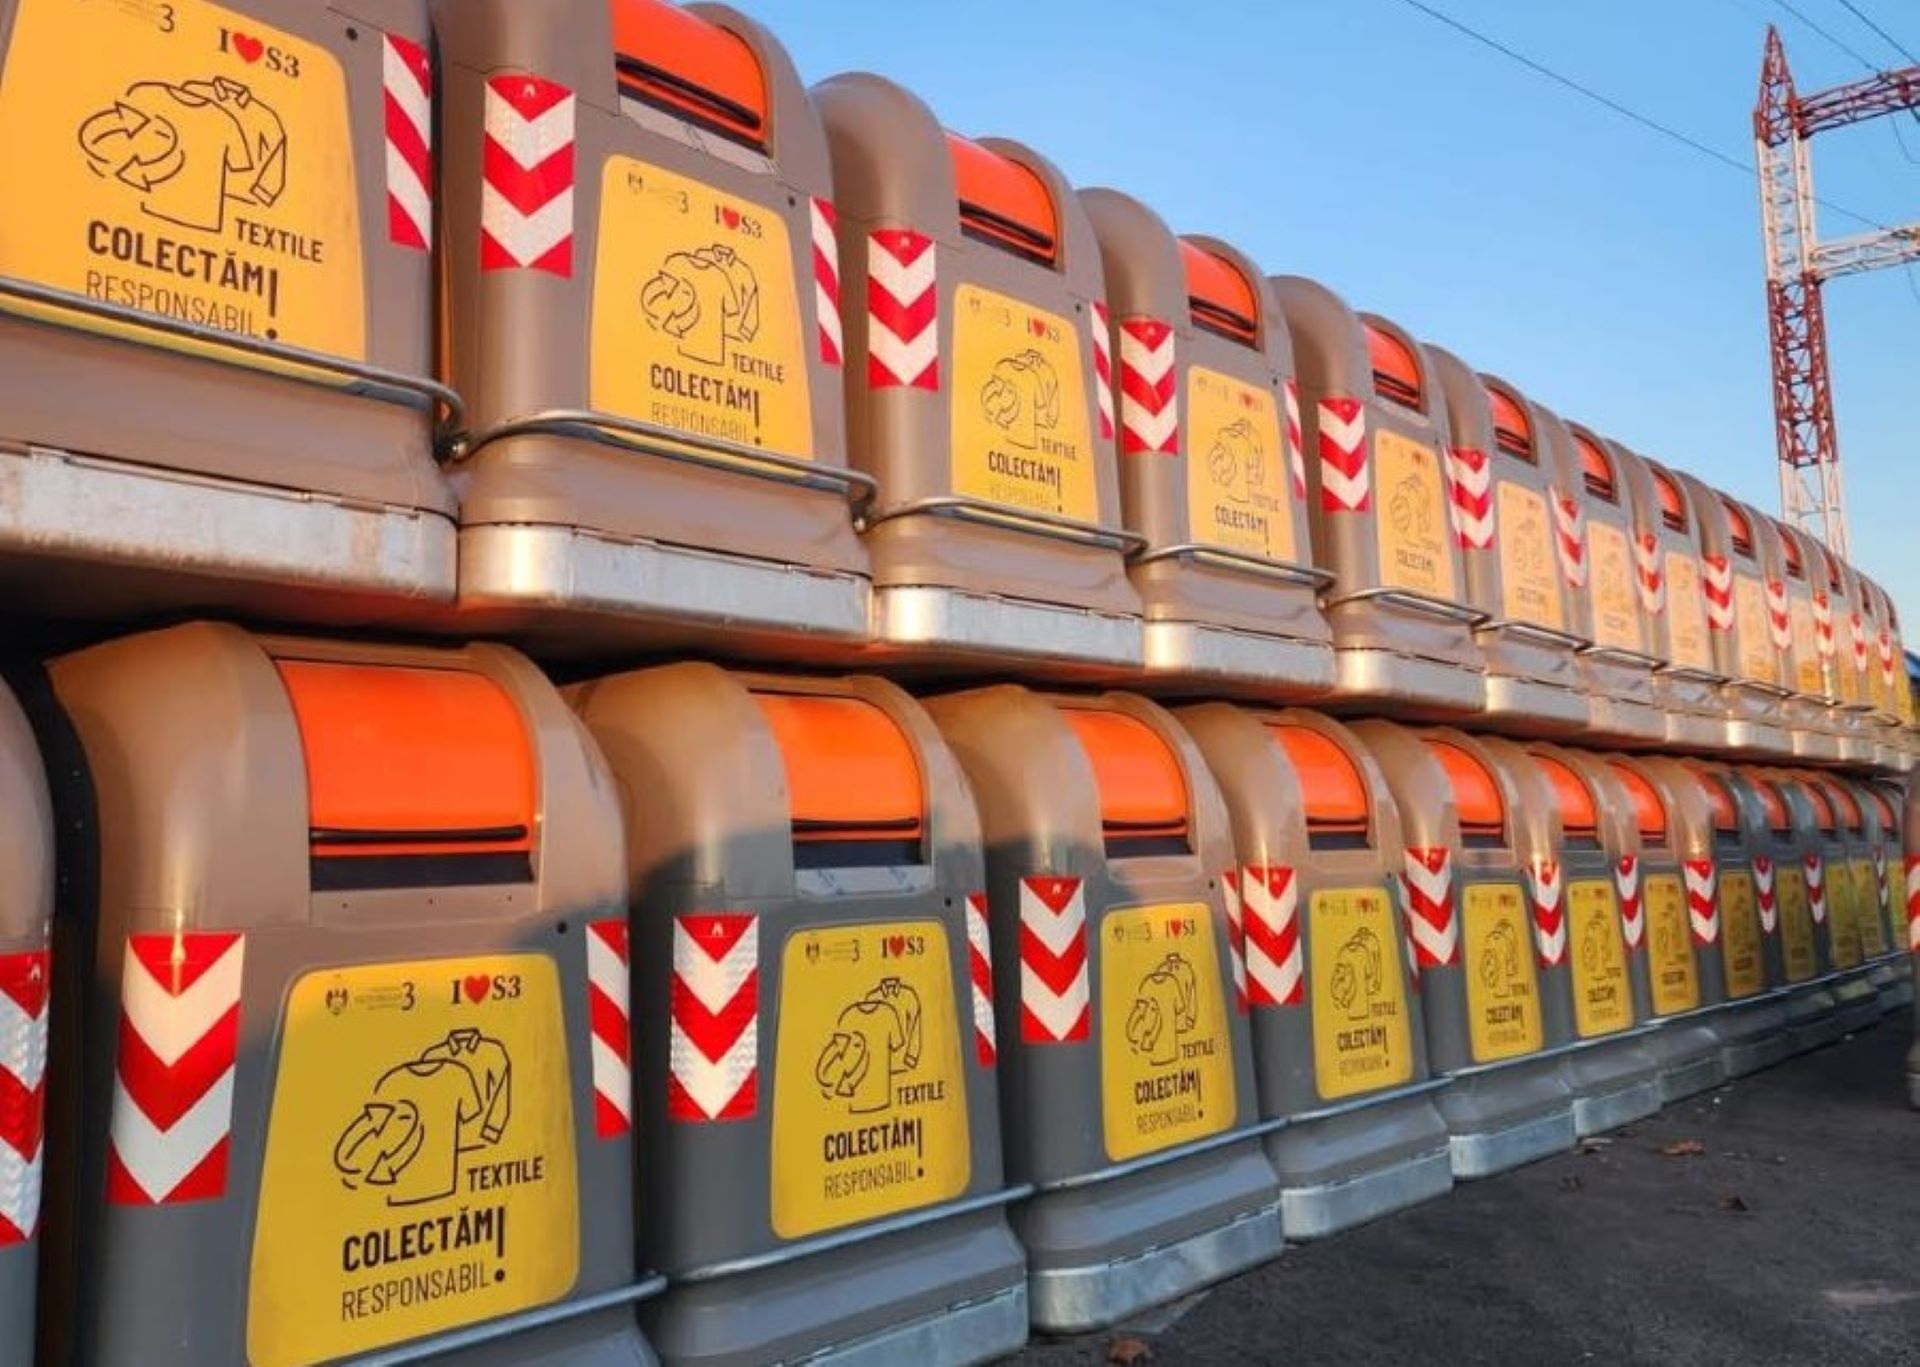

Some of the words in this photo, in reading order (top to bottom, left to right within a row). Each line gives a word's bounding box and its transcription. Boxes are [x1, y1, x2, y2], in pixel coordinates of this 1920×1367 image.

[159, 4, 175, 33] 3
[264, 45, 300, 78] S3
[235, 217, 323, 263] TEXTILE
[732, 352, 785, 385] TEXTILE
[401, 981, 415, 1011] 3
[491, 974, 522, 1001] S3
[897, 1079, 946, 1106] TEXTILE
[467, 1155, 544, 1193] TEXTILE
[341, 1262, 490, 1322] RESPONSABIL
